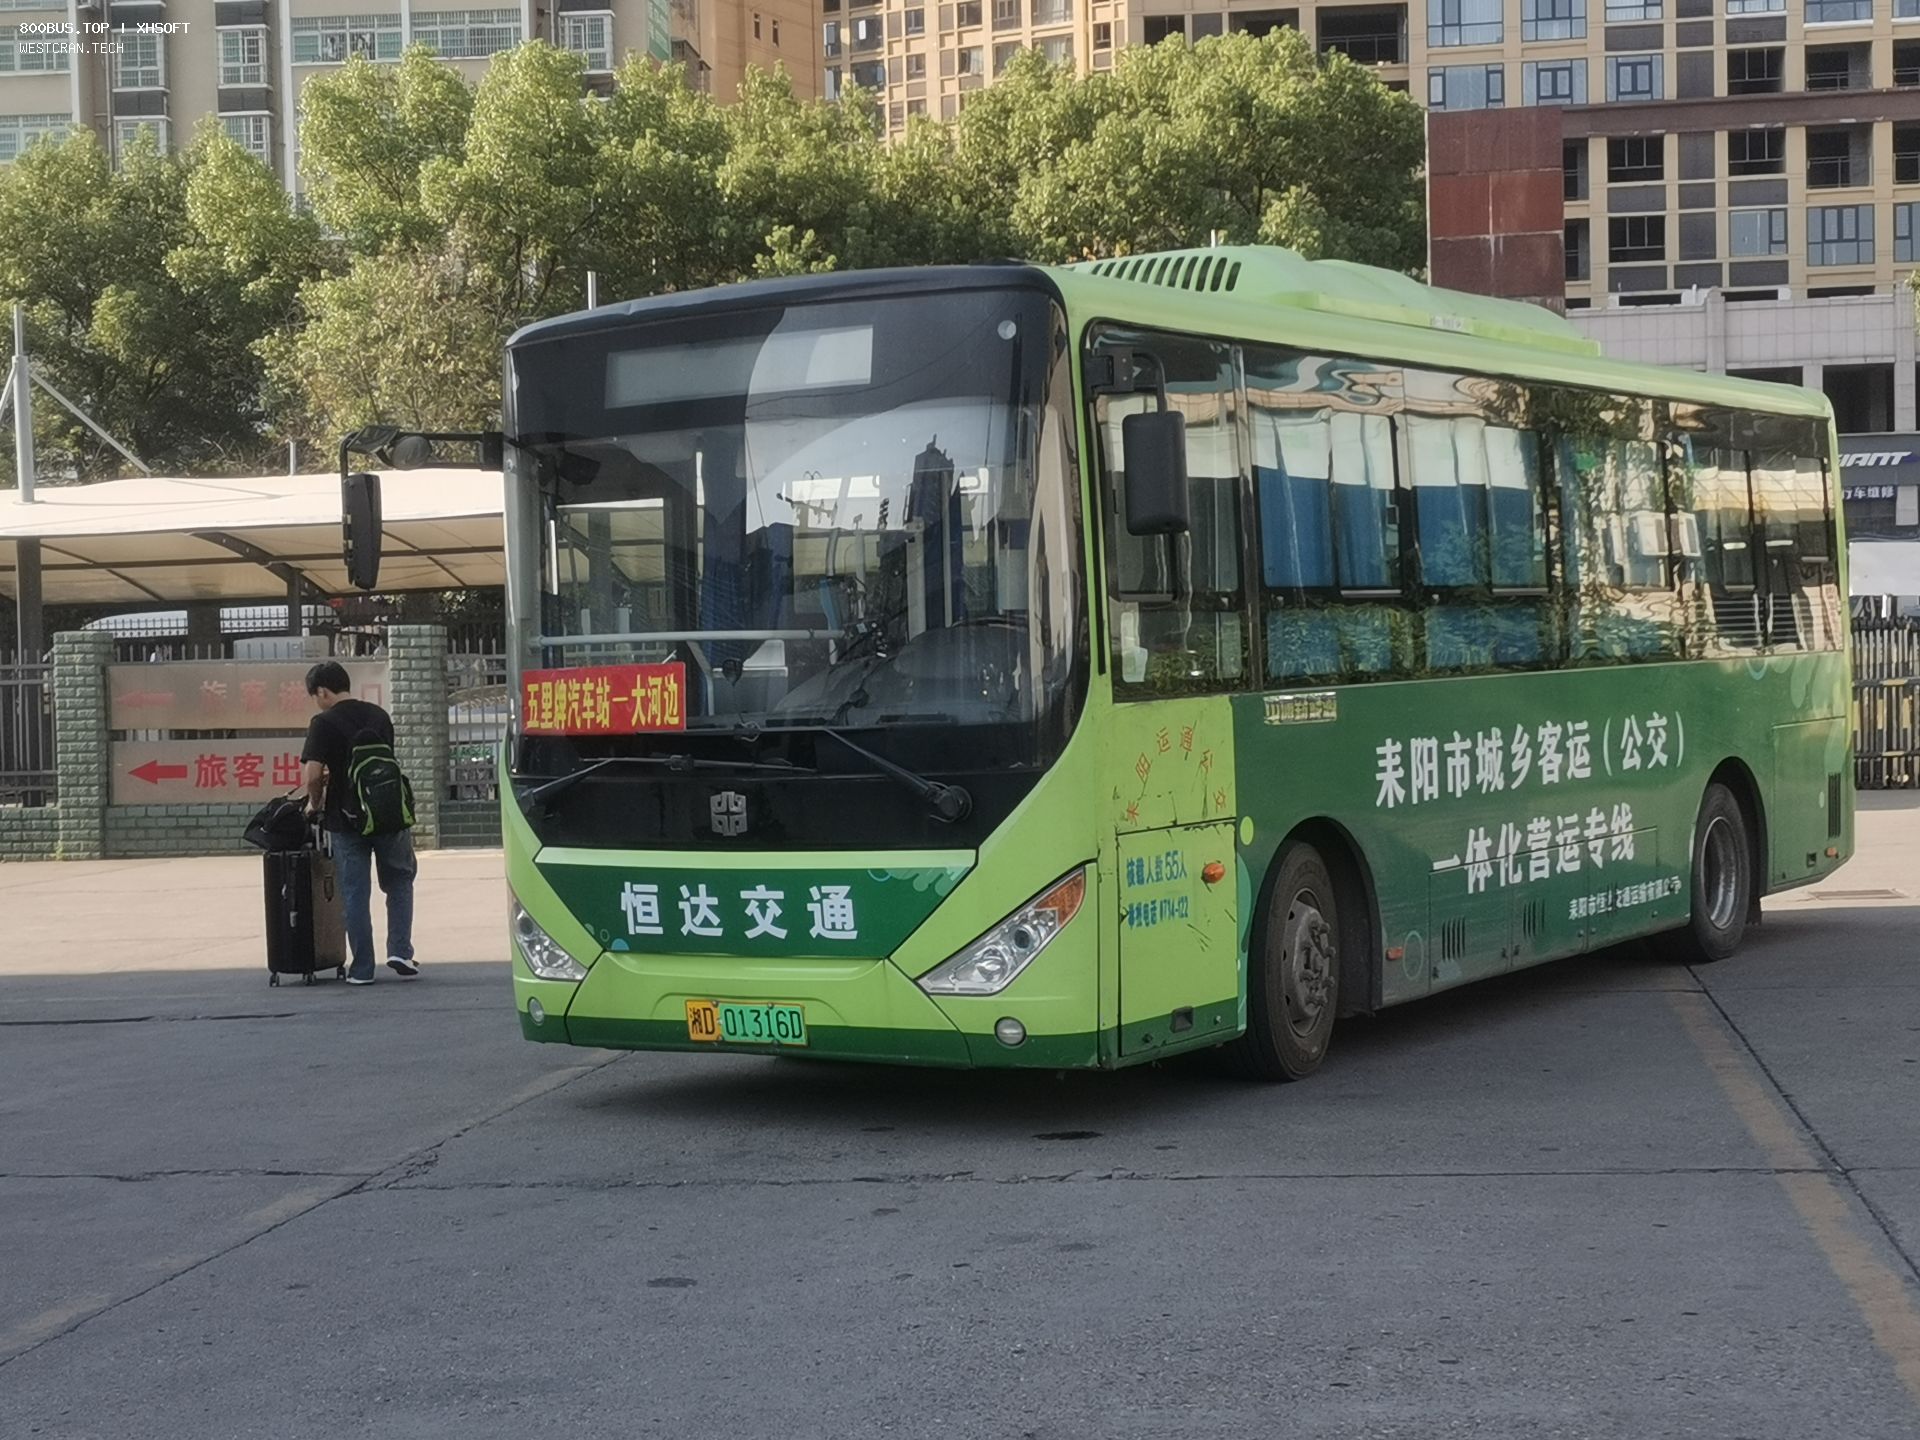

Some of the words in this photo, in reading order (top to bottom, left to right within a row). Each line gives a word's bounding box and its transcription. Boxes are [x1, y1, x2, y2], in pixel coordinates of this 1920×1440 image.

[1839, 451, 1912, 468] IANT
[1432, 802, 1635, 894] 一体化营运专线
[621, 881, 858, 939] 恒达交通
